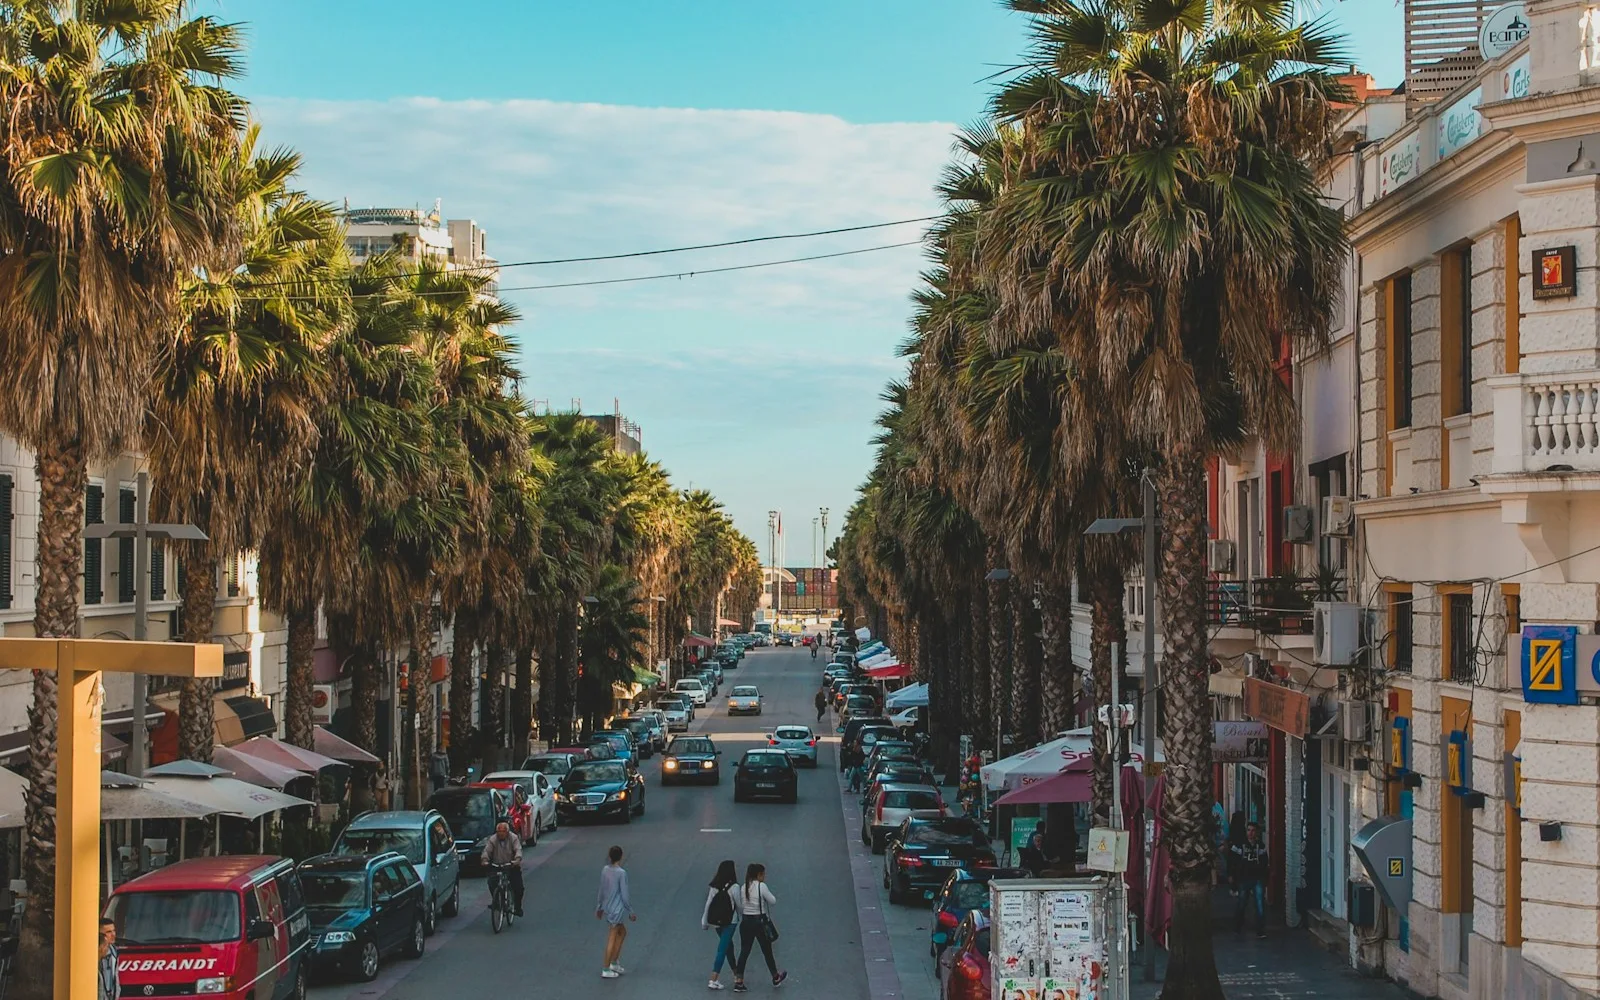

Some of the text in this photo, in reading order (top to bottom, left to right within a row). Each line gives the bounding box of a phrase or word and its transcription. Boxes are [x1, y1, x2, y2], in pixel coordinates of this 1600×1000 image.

[1489, 29, 1530, 43] Bane
[1513, 68, 1530, 98] Carls
[1447, 103, 1475, 147] Carlsberg
[1389, 145, 1413, 184] Carlsberg
[118, 958, 217, 972] USBRANDT
